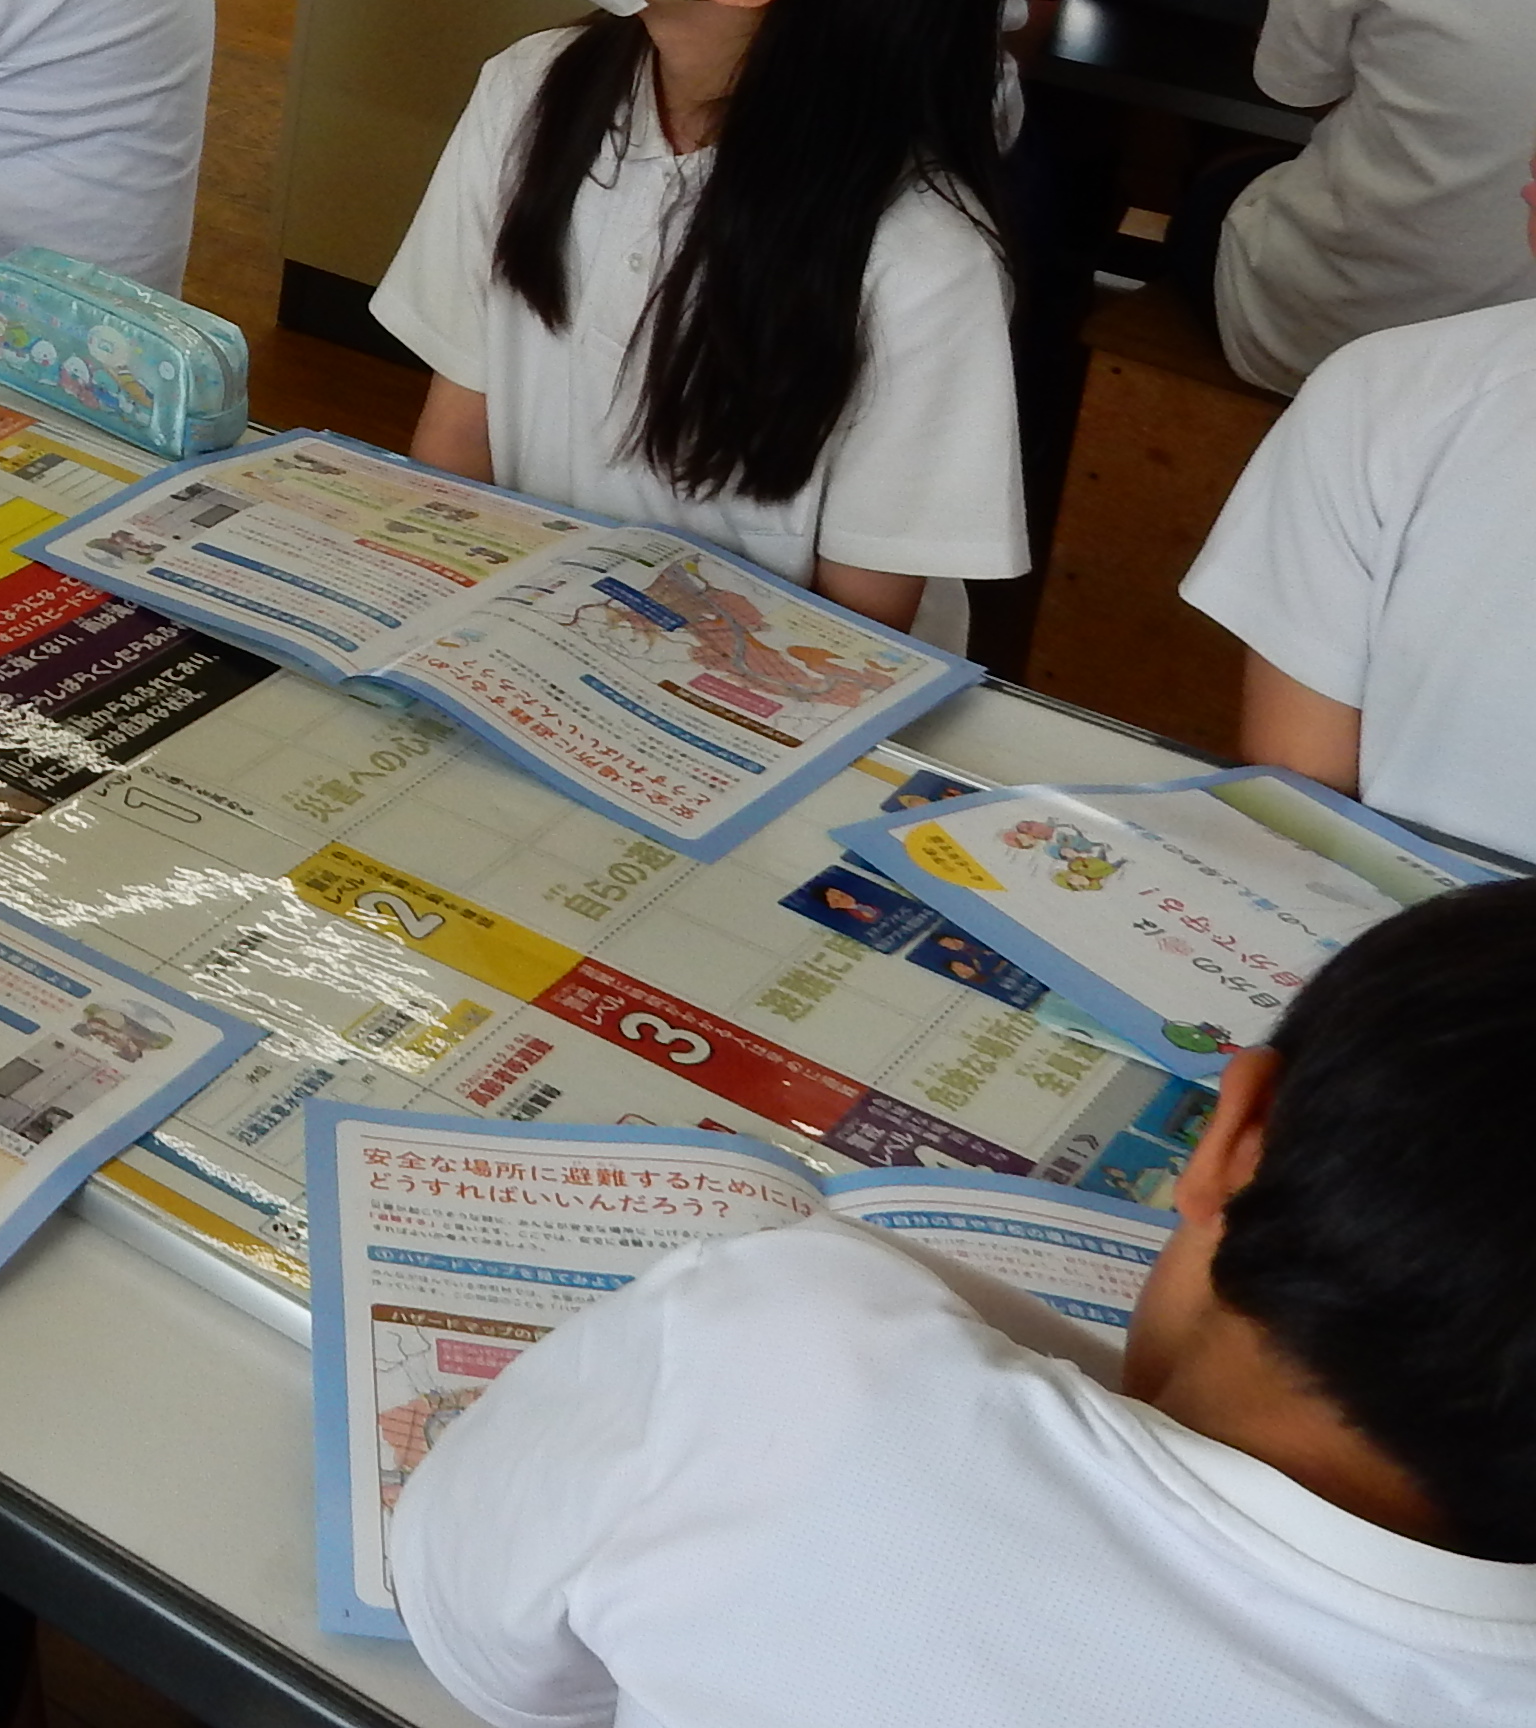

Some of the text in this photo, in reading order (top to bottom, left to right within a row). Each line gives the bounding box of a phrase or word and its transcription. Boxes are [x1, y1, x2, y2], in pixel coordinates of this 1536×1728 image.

[124, 785, 202, 824] 1
[354, 889, 447, 941] 2
[581, 994, 627, 1027] レベル
[618, 1010, 714, 1066] 3
[362, 1146, 815, 1218] 安全な場所に避難するためには
[369, 1170, 731, 1219] どうすればいいんだろう？
